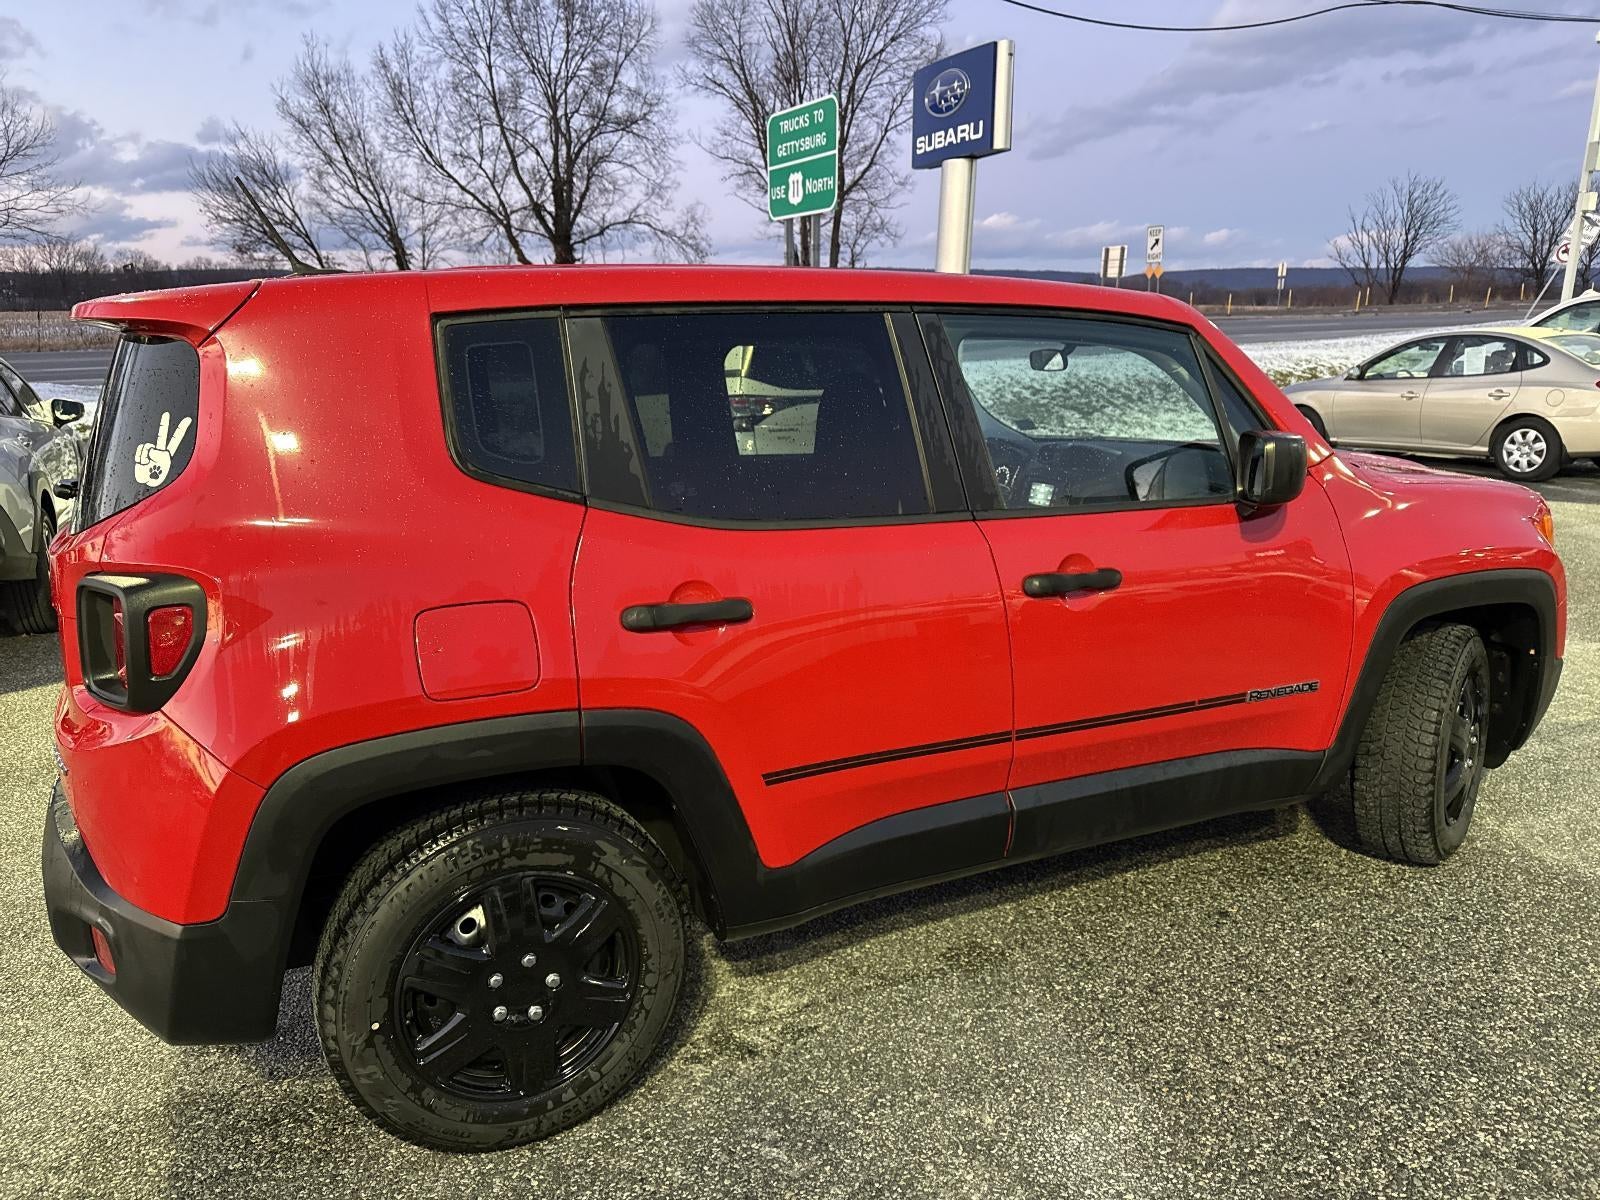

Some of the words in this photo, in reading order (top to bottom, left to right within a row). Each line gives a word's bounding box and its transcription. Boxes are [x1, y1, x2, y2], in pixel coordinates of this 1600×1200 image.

[779, 113, 810, 135] TRUCKS
[813, 108, 824, 123] TO
[777, 132, 827, 158] GETTYSBURG
[916, 120, 984, 155] SUBARU
[771, 185, 786, 200] USE
[791, 179, 800, 199] 11
[805, 176, 834, 195] NORTH
[1149, 229, 1162, 237] KEEP
[1148, 252, 1162, 260] RIGHT
